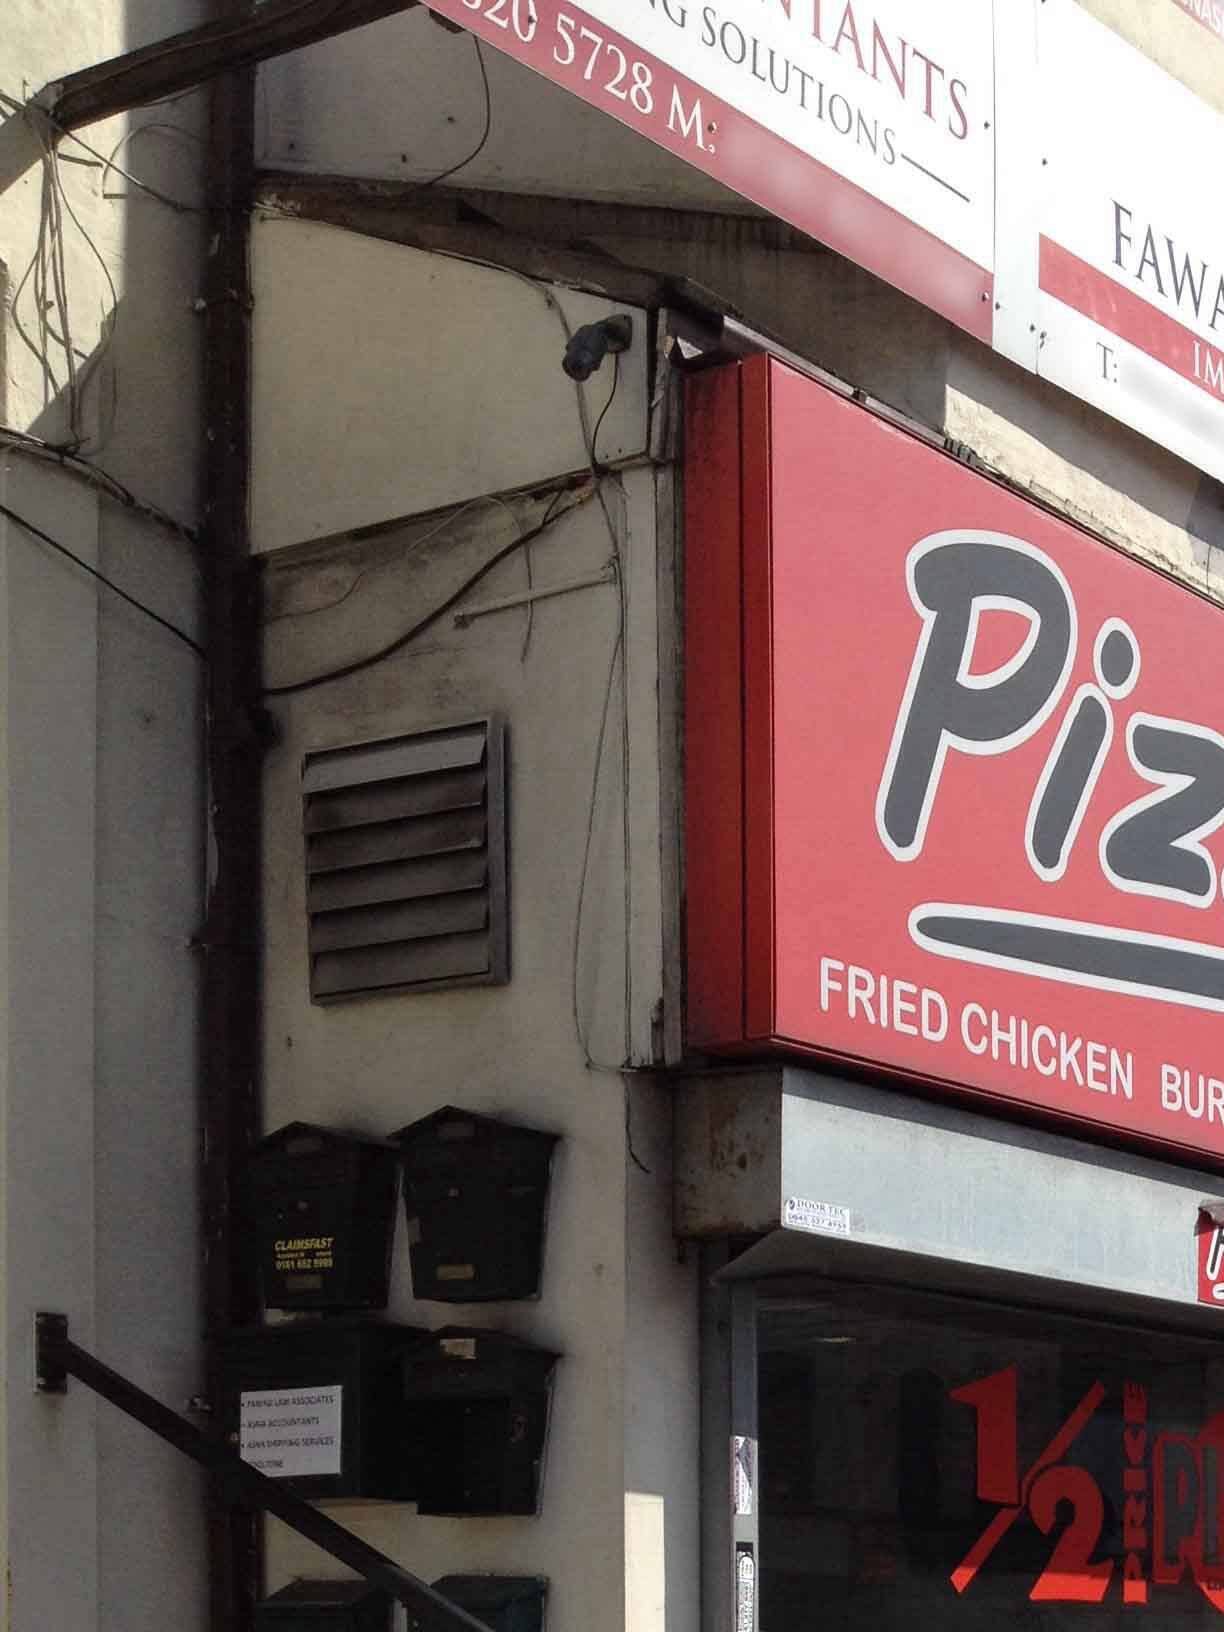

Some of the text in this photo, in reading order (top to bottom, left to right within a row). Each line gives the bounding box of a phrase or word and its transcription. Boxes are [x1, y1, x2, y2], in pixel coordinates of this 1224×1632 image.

[553, 13, 654, 114] 5728
[701, 6, 896, 165] SOLUTIONS
[780, 0, 968, 140] TANTS
[819, 956, 949, 1042] FRIED
[961, 1002, 1134, 1099] CHICKEN
